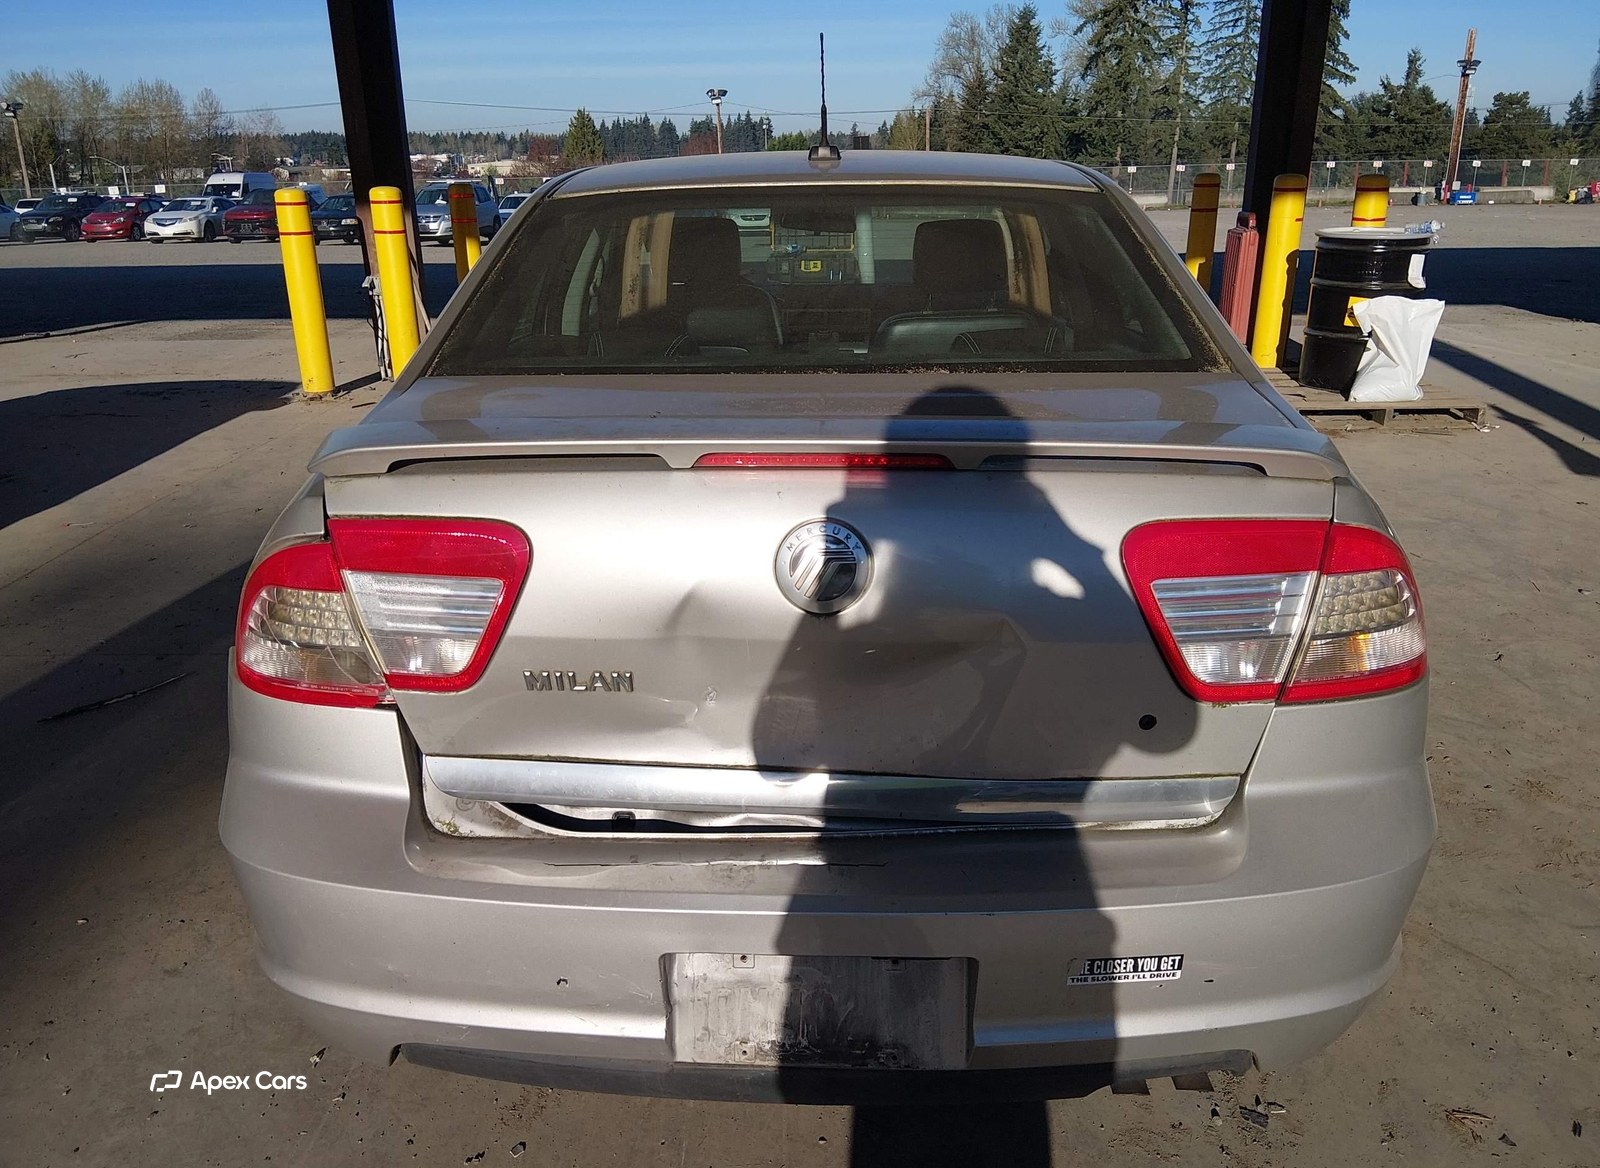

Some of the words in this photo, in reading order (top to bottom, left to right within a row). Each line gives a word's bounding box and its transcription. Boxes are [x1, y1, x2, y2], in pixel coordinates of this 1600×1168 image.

[786, 525, 862, 552] MERCURY
[523, 670, 634, 692] MILAN
[1093, 958, 1135, 974] CLOSER
[1137, 957, 1159, 972] YOU
[1160, 955, 1181, 971] GET
[1090, 974, 1130, 982] SLOWER
[1149, 971, 1178, 979] DRIVE
